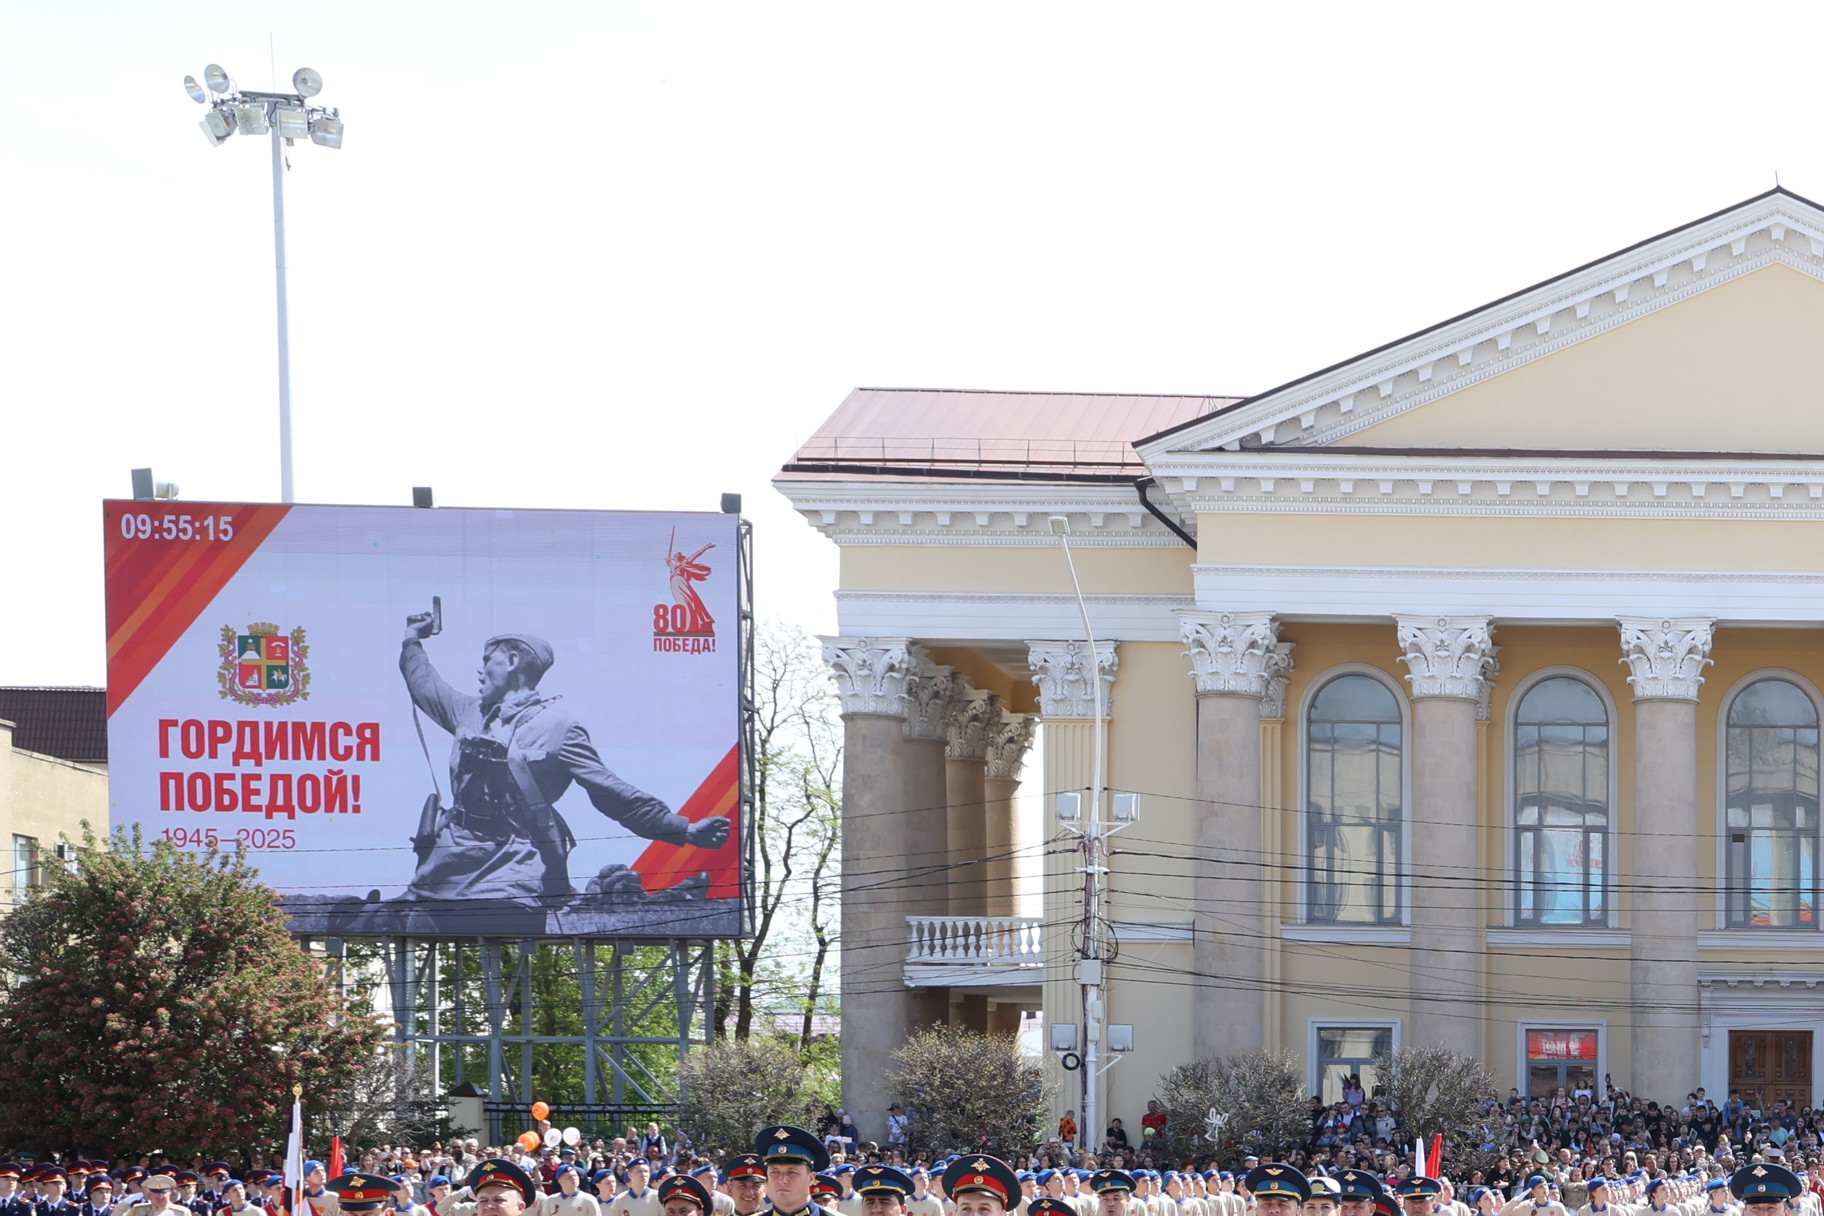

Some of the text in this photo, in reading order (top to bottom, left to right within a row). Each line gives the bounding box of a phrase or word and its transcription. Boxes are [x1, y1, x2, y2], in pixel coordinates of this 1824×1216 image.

[121, 514, 234, 541] 09:55:15
[653, 604, 687, 632] 80
[653, 638, 716, 655] ПОБЕДА!
[158, 719, 380, 767] ГОРДИМСЯ
[159, 769, 361, 820] ПОБЕДОЙ!
